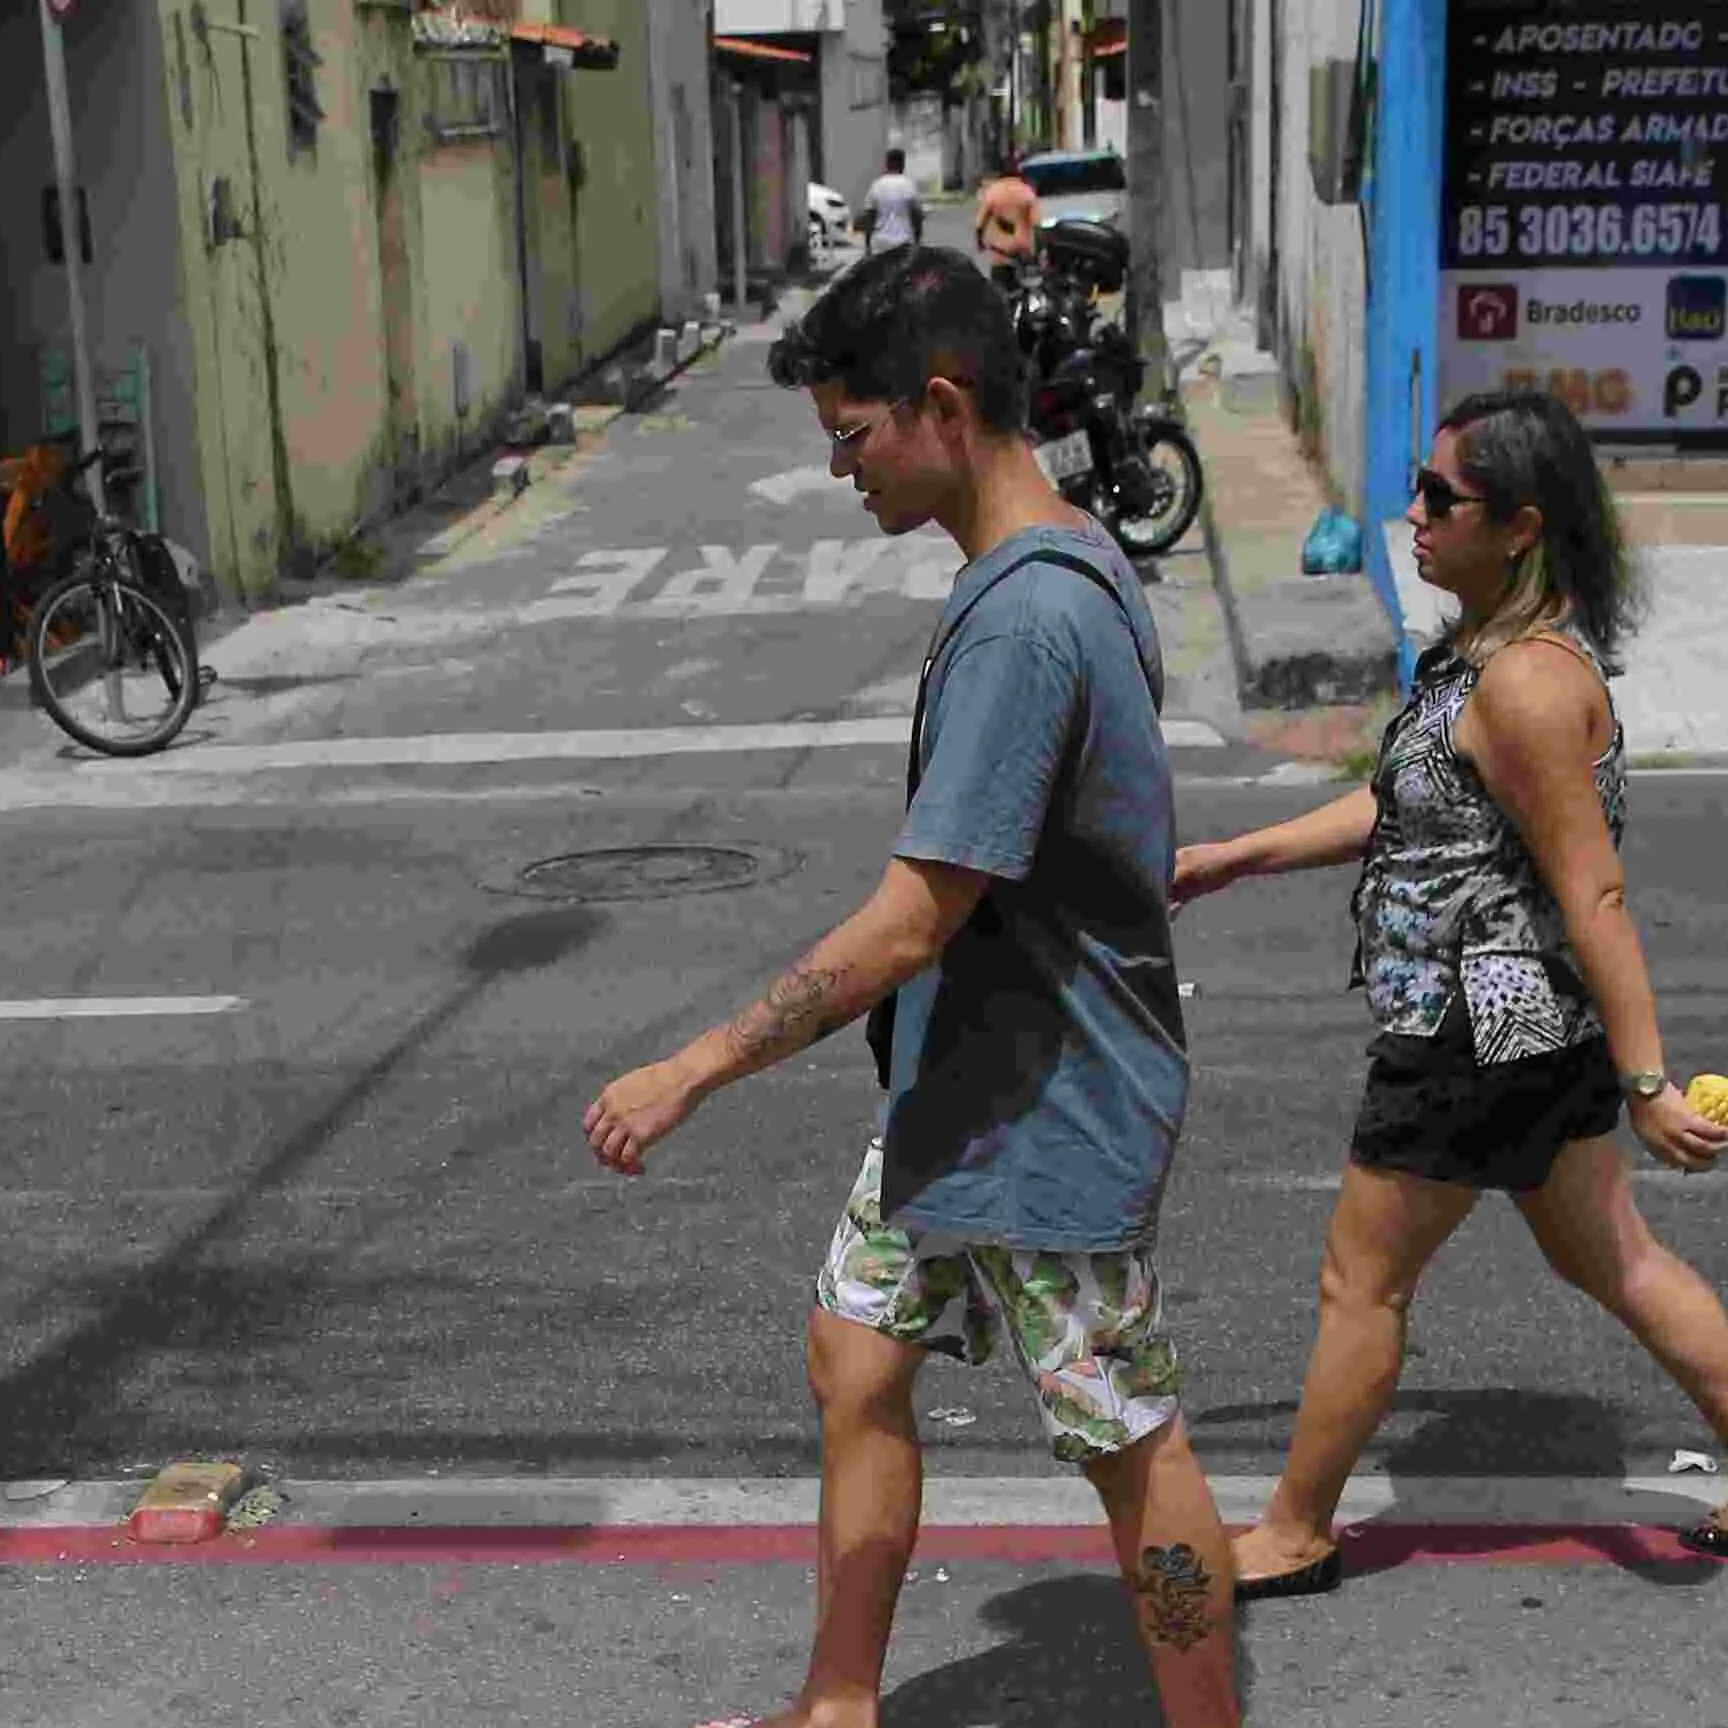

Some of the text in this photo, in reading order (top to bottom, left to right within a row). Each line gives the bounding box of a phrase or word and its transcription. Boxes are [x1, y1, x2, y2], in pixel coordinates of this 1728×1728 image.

[1493, 20, 1703, 52] APOSENTADO
[1491, 70, 1558, 98] INSS
[1490, 113, 1615, 151] FORÇAS
[1488, 160, 1621, 189] FEDERAL
[1459, 205, 1510, 255] 85
[1526, 299, 1641, 325] Bradesco
